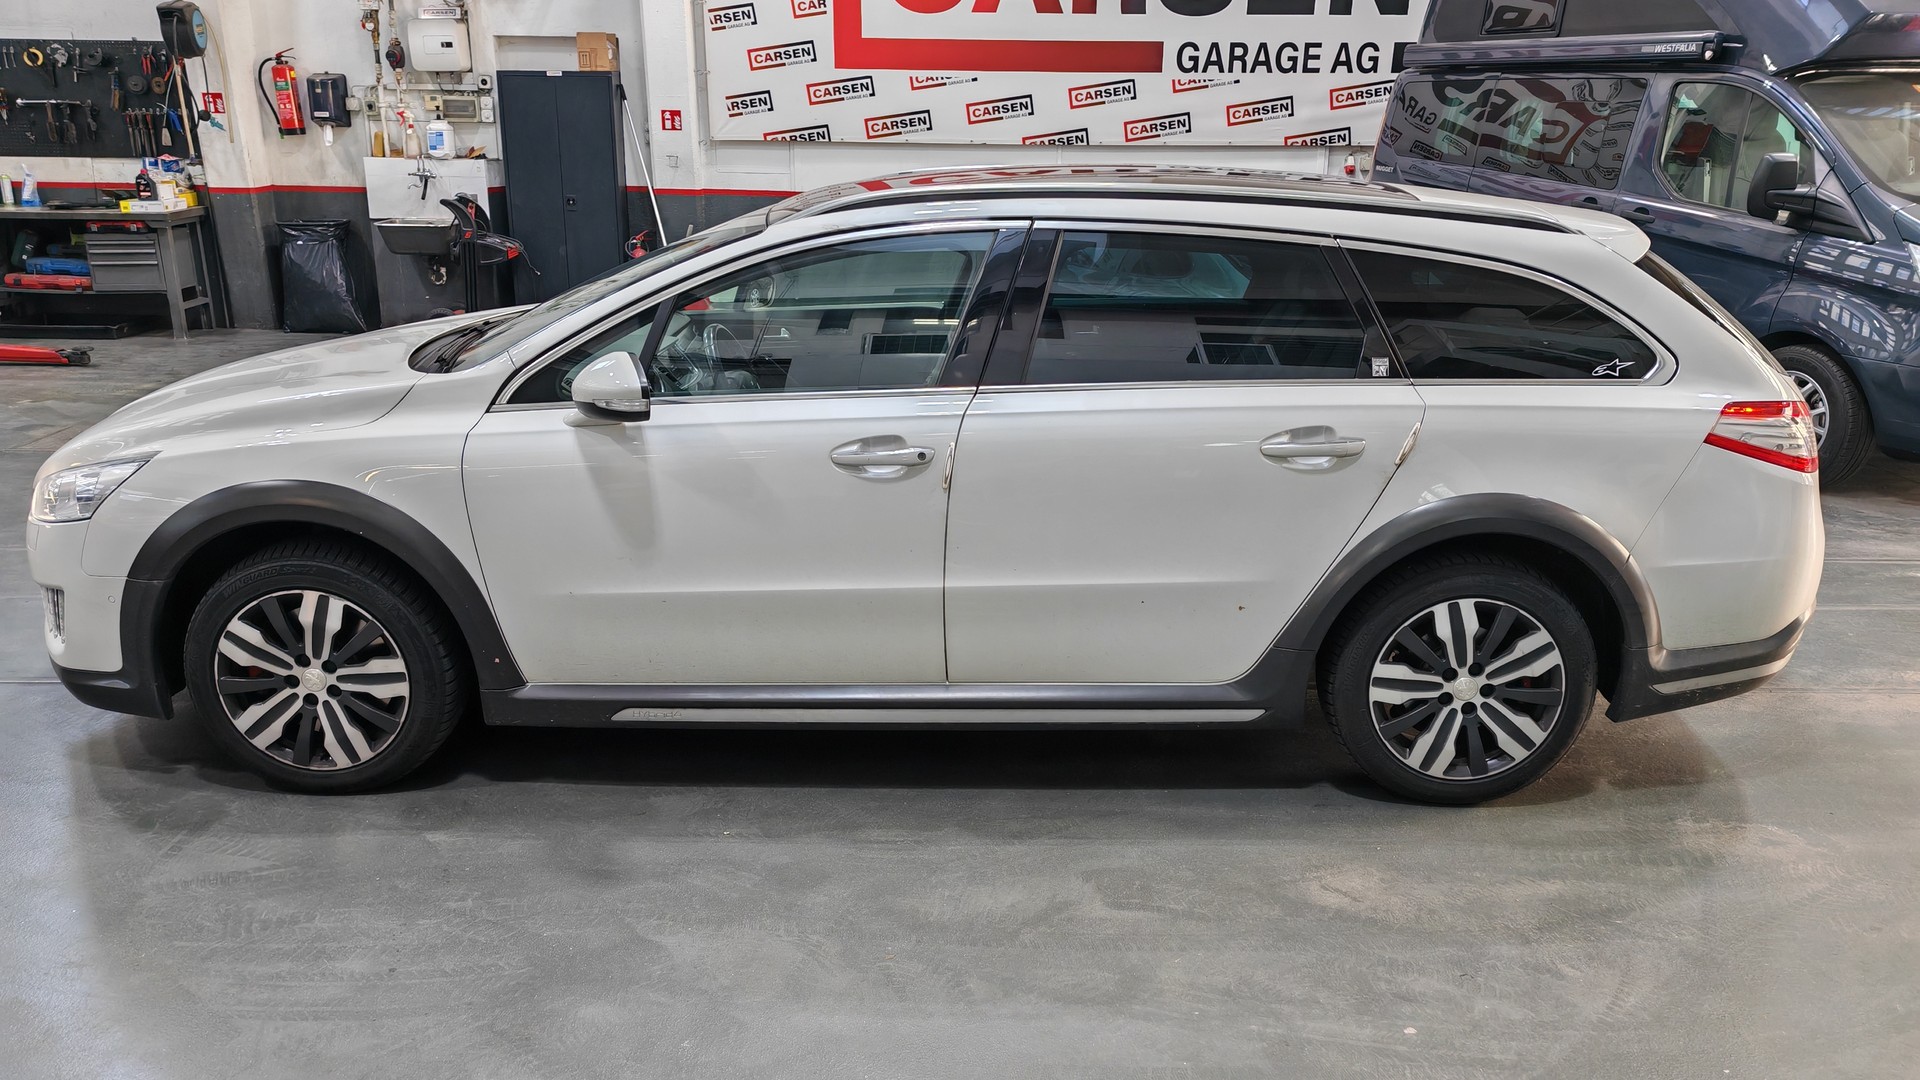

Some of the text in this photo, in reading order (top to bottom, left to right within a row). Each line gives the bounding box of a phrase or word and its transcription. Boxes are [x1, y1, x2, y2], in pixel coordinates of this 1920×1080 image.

[753, 46, 811, 64] CARSEN
[1654, 43, 1697, 53] WESTFALIA
[1176, 42, 1380, 74] GARAGE AG
[813, 82, 870, 99] CARSEN
[1074, 85, 1132, 103] CARSEN
[1335, 86, 1393, 104] CARSEN
[972, 101, 1029, 118] CARSEN
[1232, 102, 1289, 120] CARSEN
[870, 115, 928, 133] CARSEN
[1129, 118, 1187, 136] CARSEN
[1376, 165, 1394, 173] NUGGET
[222, 566, 278, 598] WINGUARD
